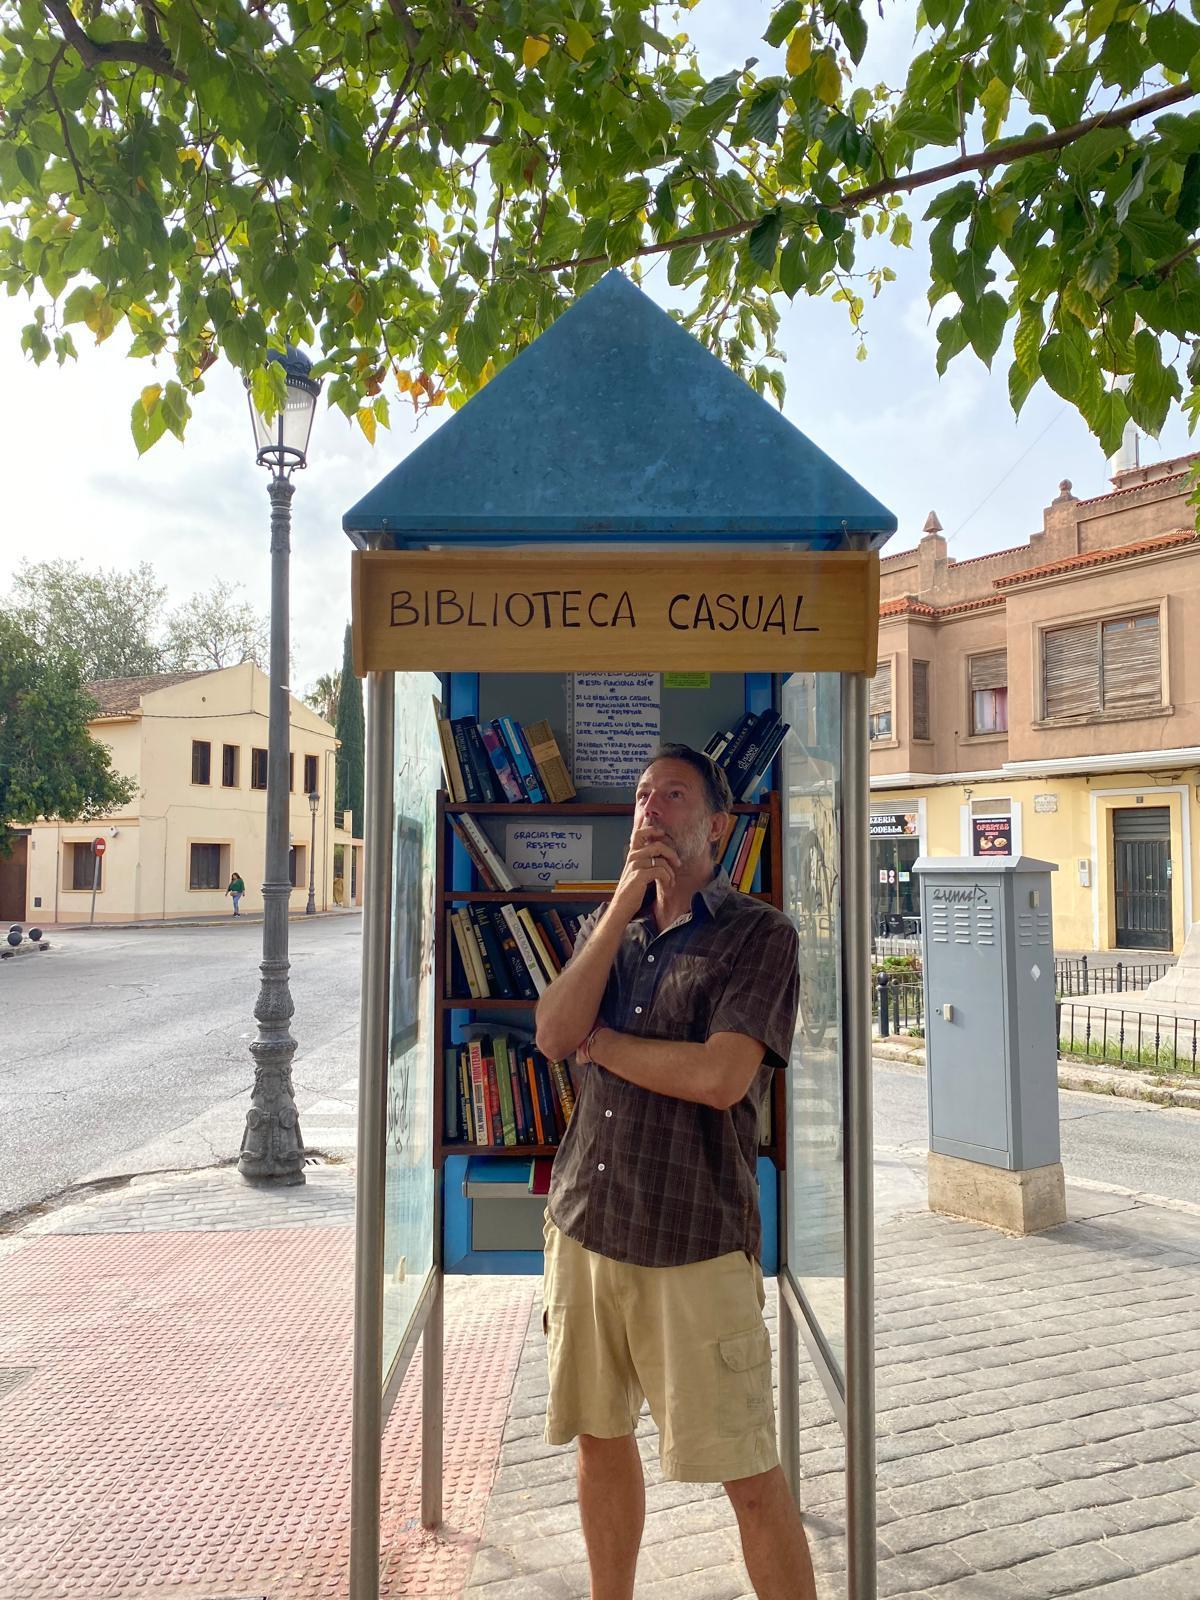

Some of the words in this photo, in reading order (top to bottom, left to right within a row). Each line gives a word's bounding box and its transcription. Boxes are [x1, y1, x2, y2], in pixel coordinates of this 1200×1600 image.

[389, 588, 637, 630] BIBLIOTECA
[667, 592, 821, 635] CASUAL
[513, 832, 550, 840] GRACIAS
[540, 850, 547, 859] Y
[512, 859, 580, 870] COLABORACIÓN
